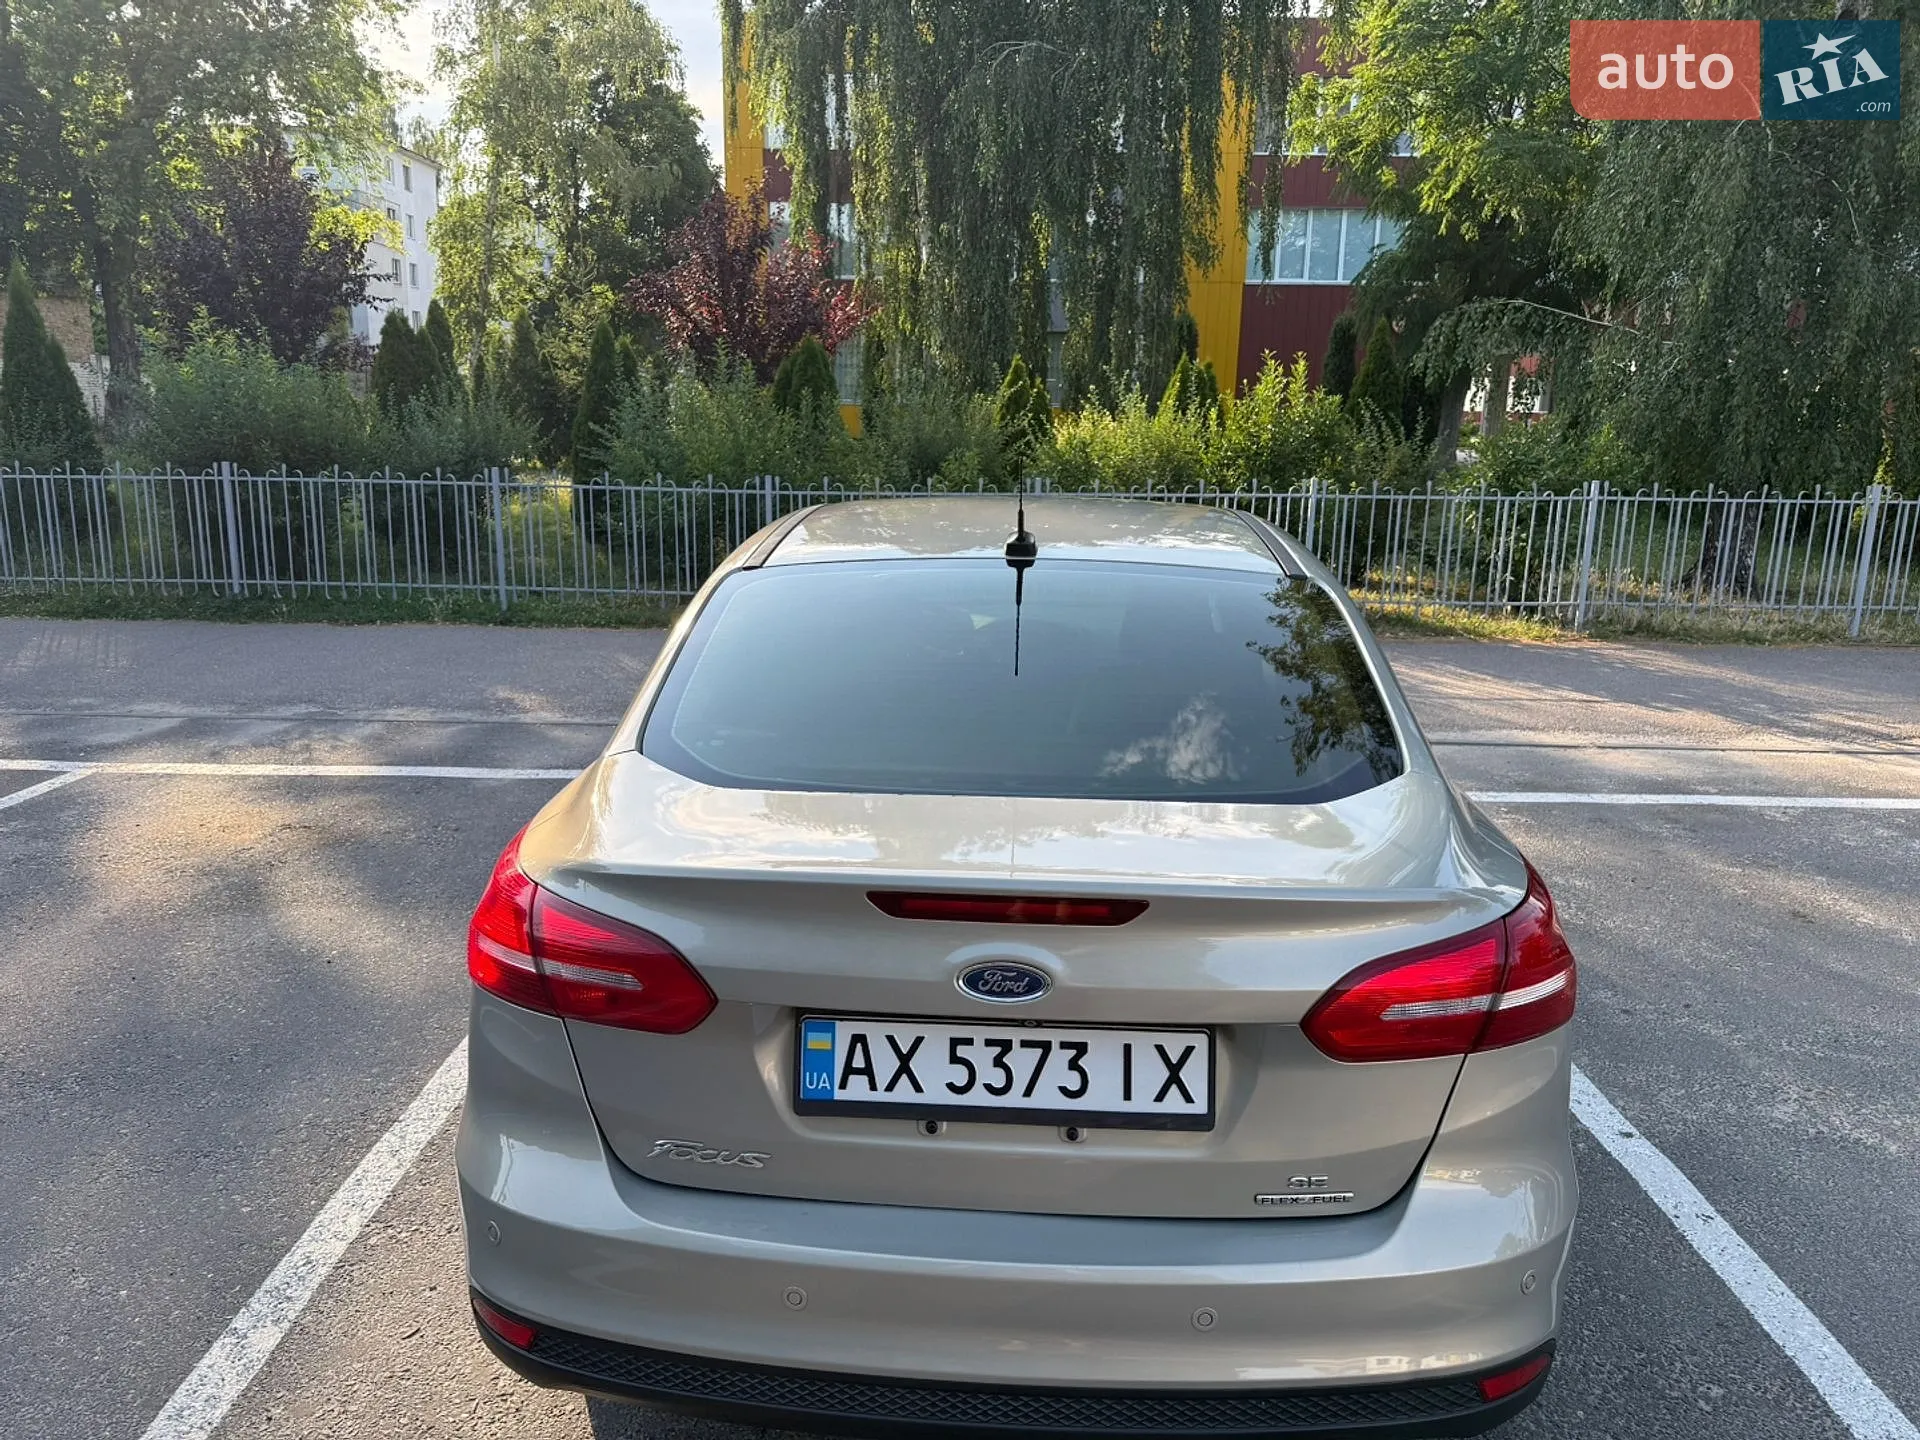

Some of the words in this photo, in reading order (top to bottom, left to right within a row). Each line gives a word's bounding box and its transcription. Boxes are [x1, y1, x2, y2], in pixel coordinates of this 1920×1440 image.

[978, 969, 1030, 993] Ford
[838, 1033, 926, 1093] AX
[945, 1037, 1090, 1099] 5373
[1122, 1043, 1197, 1104] IX
[806, 1071, 831, 1090] UA
[1288, 1176, 1328, 1188] SE
